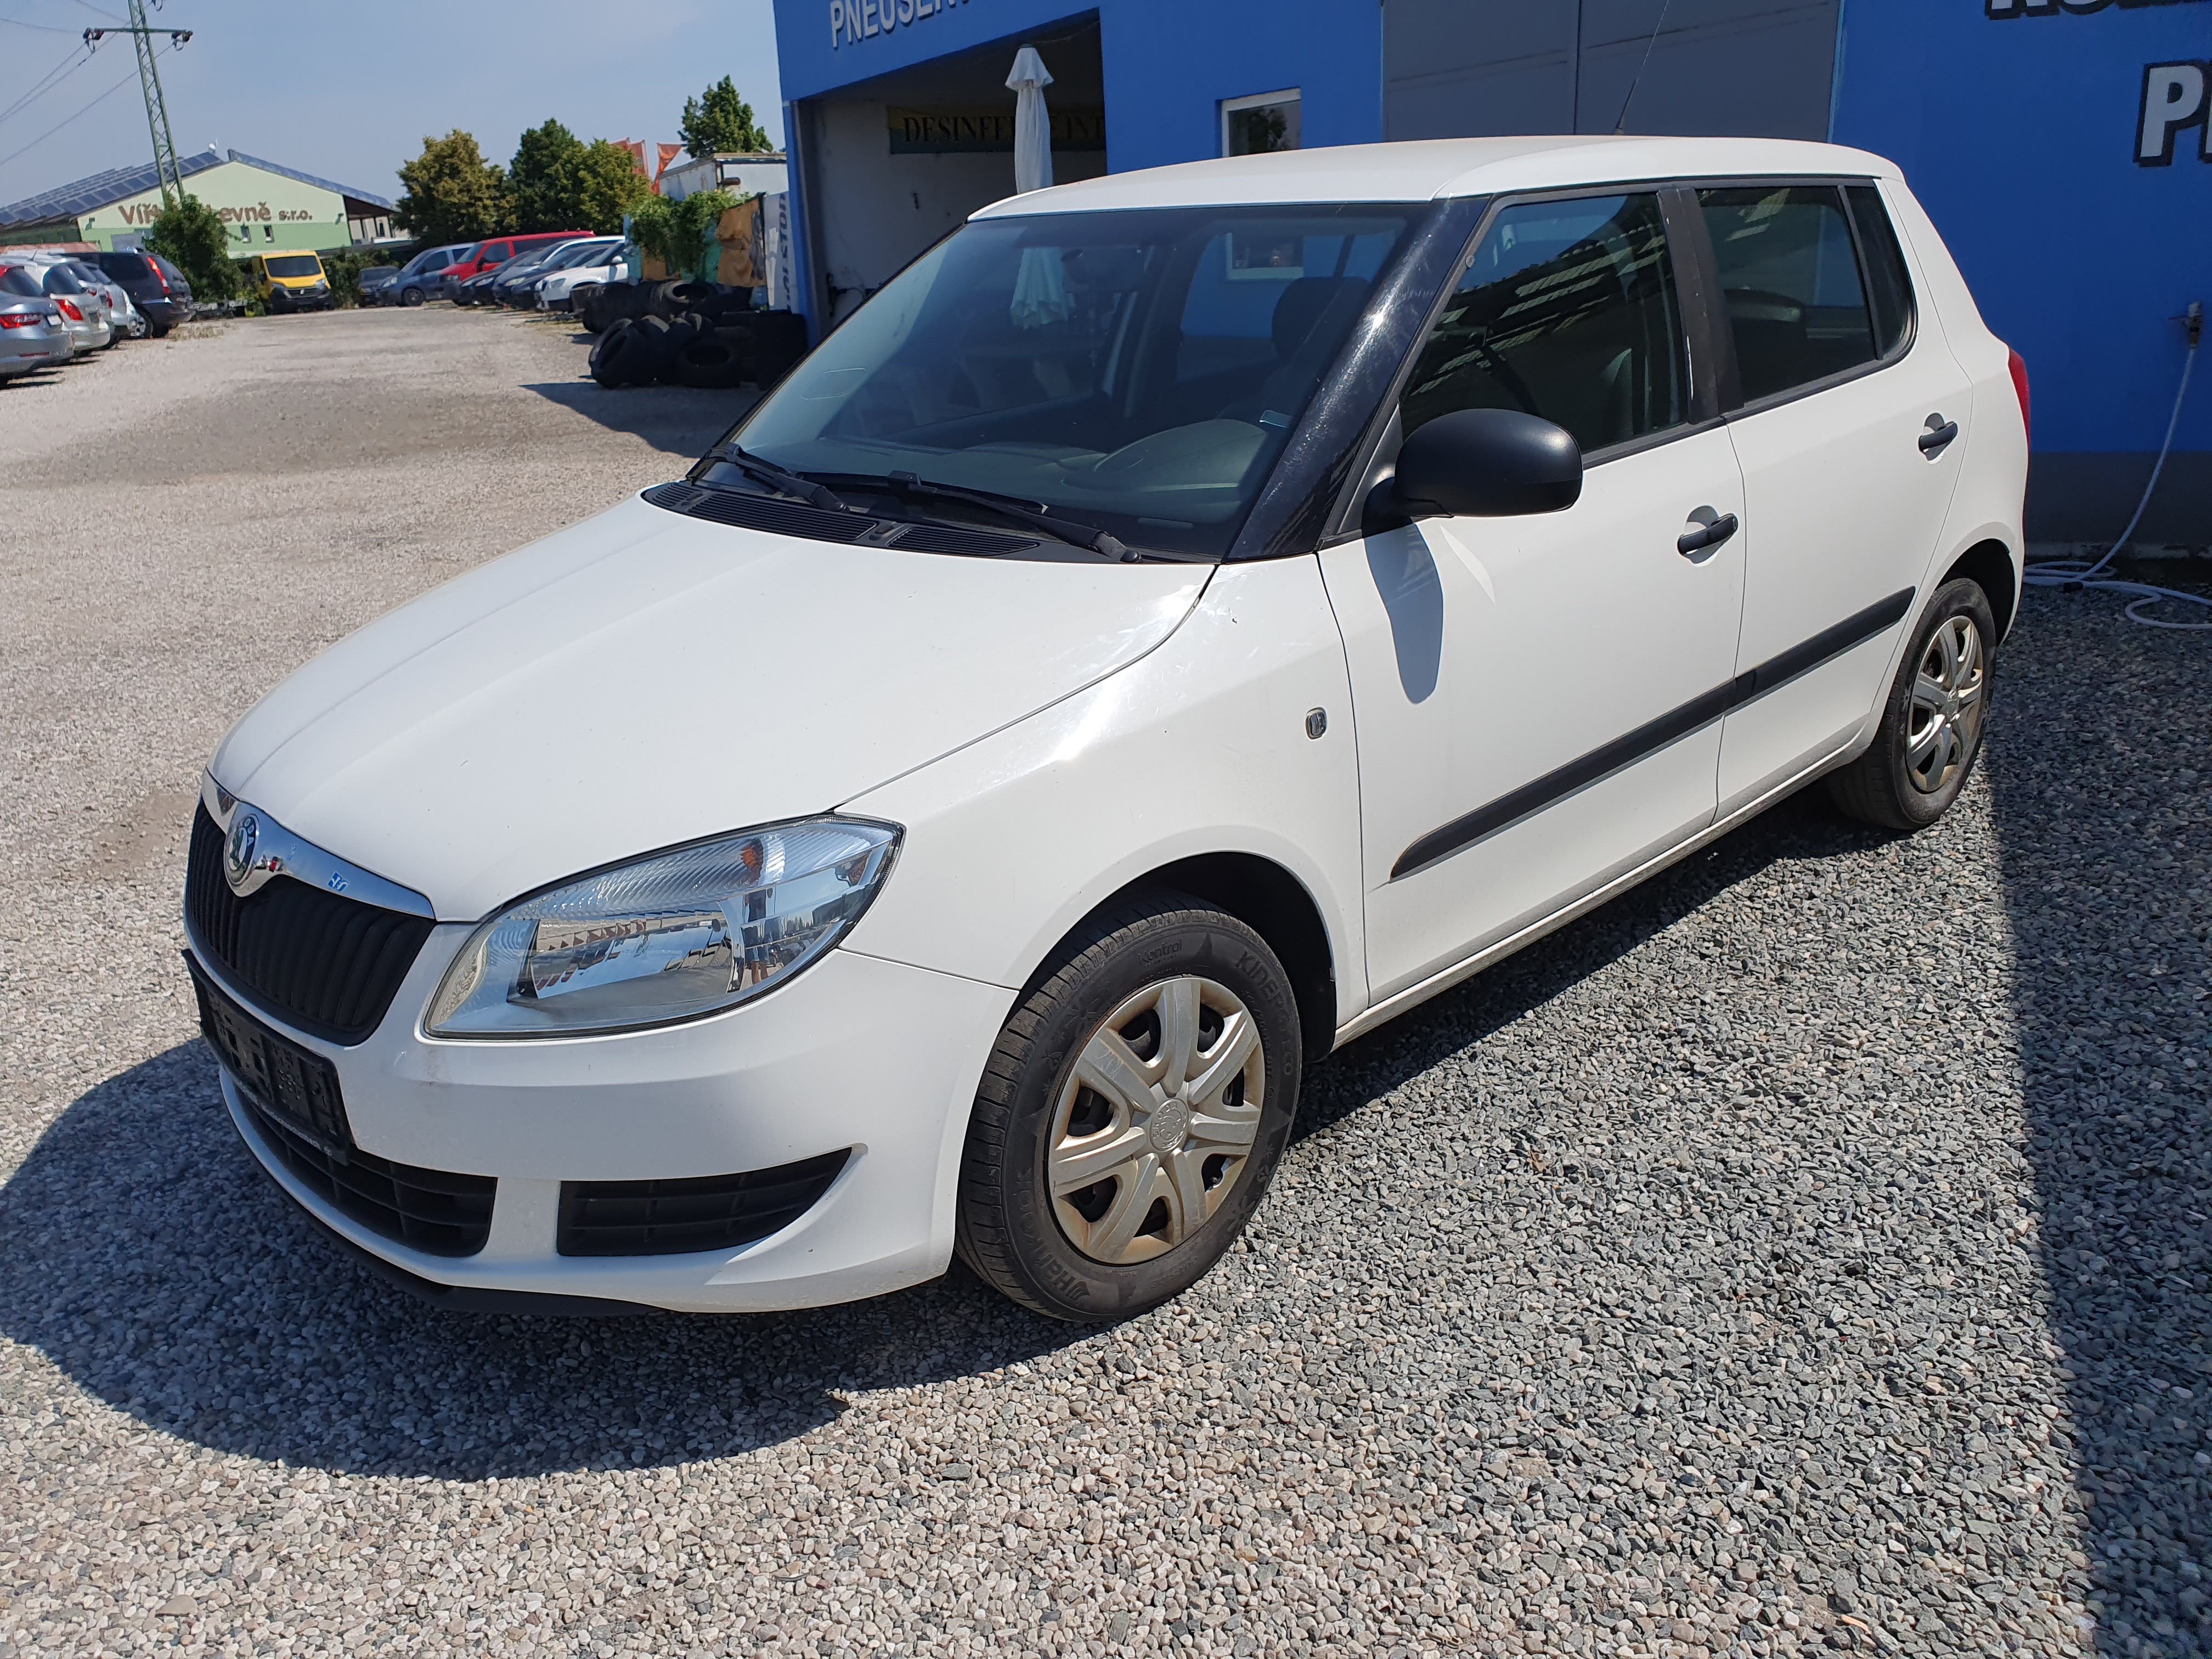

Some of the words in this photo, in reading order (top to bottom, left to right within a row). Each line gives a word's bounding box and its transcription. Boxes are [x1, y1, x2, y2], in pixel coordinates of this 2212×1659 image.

[2134, 60, 2212, 166] P
[206, 201, 272, 223] evně
[278, 209, 313, 221] s.r.o.
